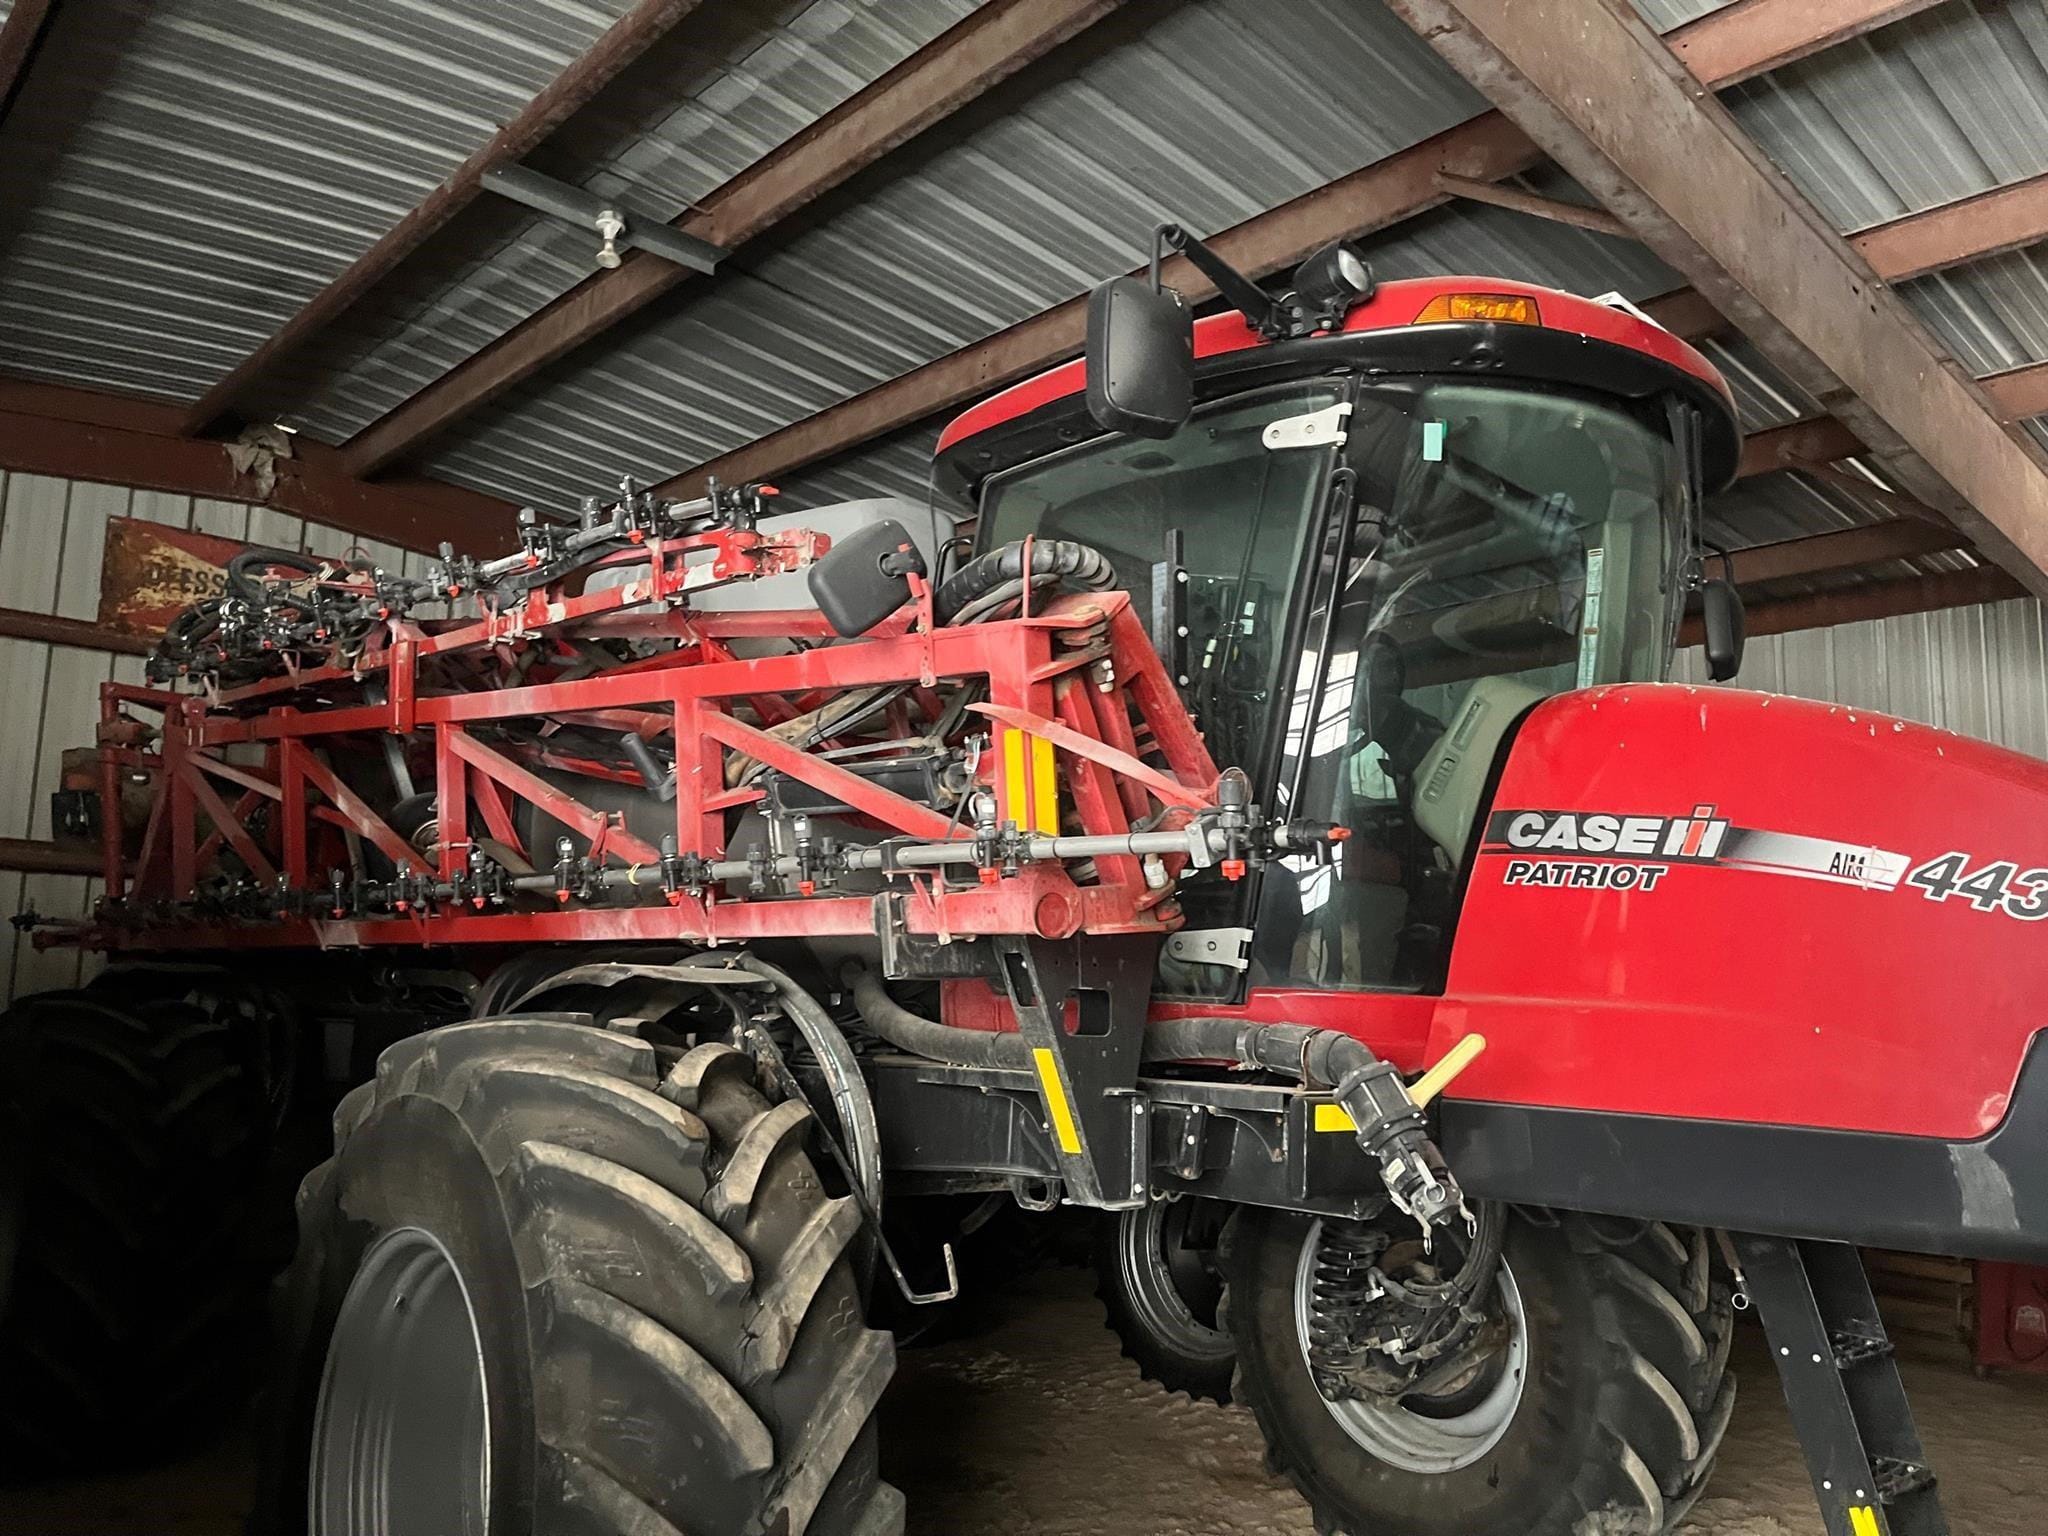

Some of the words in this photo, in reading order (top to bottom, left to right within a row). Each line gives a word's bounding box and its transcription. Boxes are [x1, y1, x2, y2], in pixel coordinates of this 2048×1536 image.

[1507, 811, 1664, 855] CASE
[1504, 861, 1668, 891] PATRIOT
[1906, 851, 2048, 920] 443
